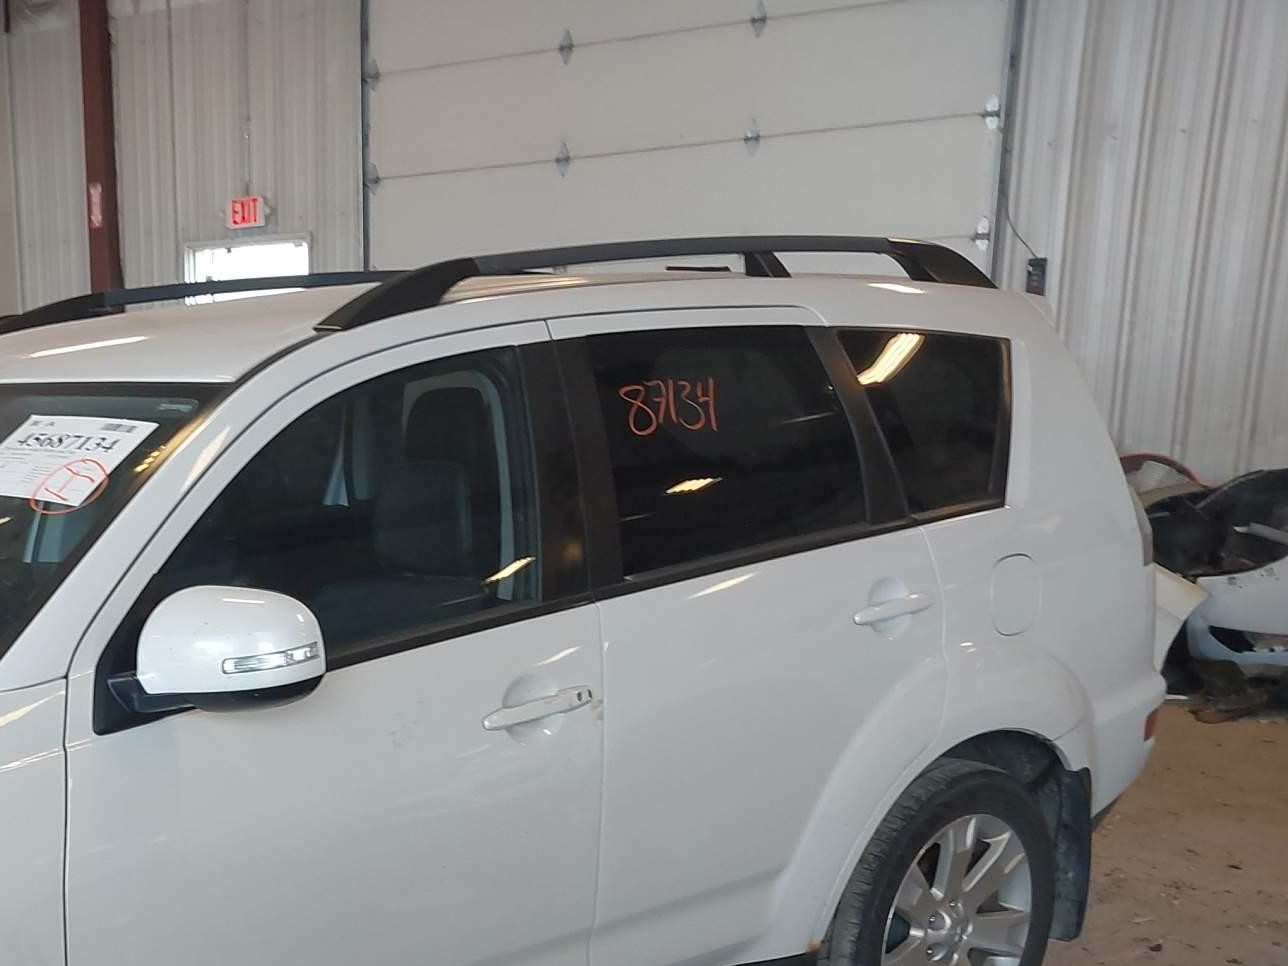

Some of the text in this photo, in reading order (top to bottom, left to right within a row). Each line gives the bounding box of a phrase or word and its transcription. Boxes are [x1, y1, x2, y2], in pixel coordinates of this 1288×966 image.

[231, 197, 259, 225] EXIT
[618, 376, 718, 437] 87134
[16, 432, 123, 453] 45687134
